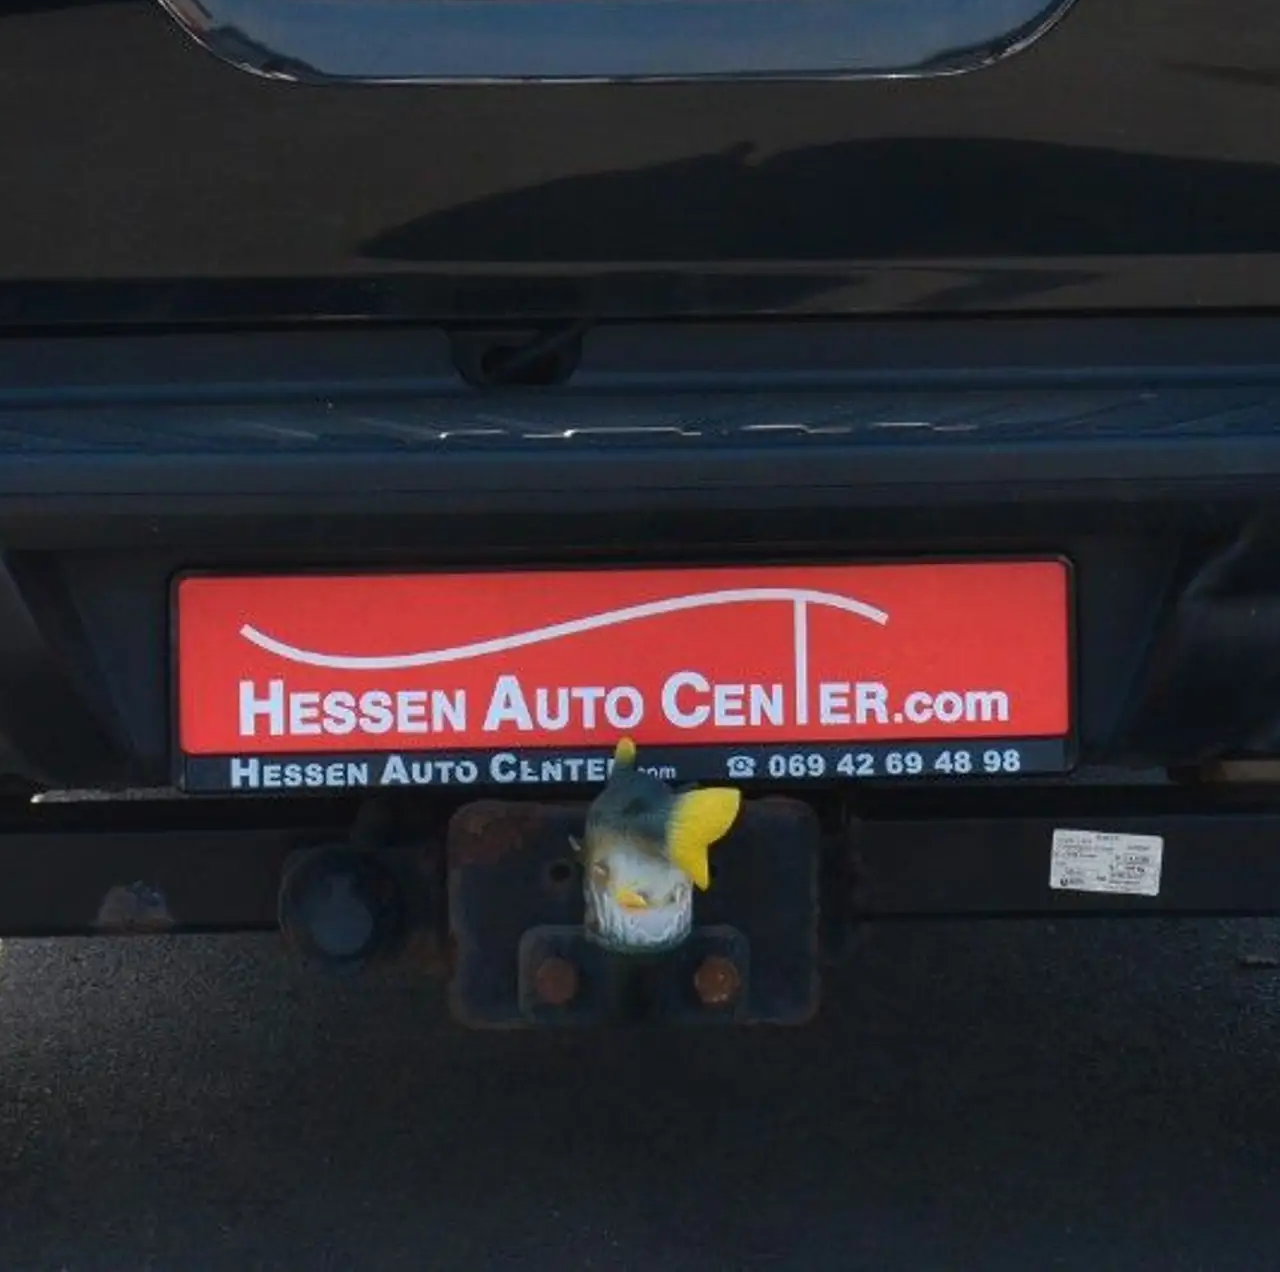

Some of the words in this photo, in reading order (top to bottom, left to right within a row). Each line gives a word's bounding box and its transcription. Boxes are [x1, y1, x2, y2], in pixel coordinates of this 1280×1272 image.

[239, 679, 466, 736] HESSEN
[482, 674, 645, 732] AUTO
[230, 758, 368, 788] HESSEN
[380, 754, 478, 785] AUTO
[768, 753, 825, 778] 069
[837, 752, 876, 777] 42
[885, 751, 923, 776] 69
[934, 749, 973, 774] 48
[983, 748, 1020, 773] 98
